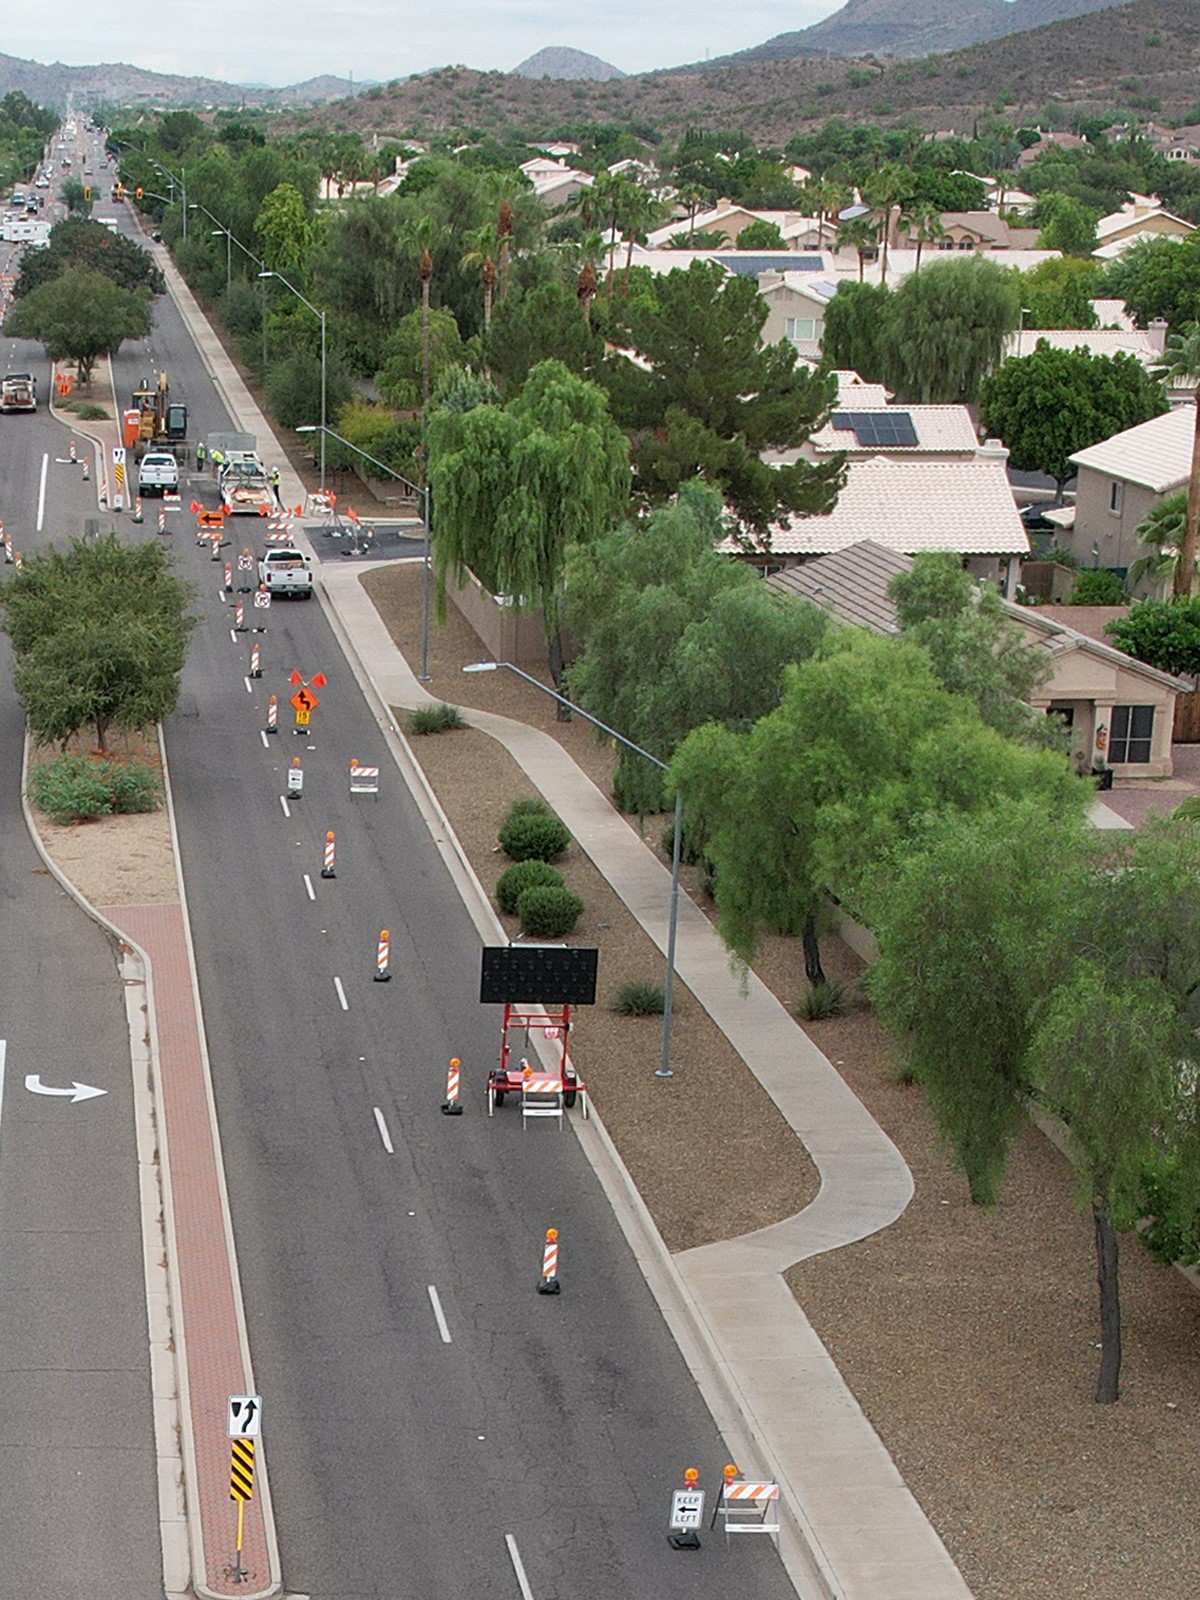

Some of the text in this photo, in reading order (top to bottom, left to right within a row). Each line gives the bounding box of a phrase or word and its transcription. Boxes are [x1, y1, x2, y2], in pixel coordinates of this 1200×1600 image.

[299, 711, 308, 720] 15
[677, 1496, 700, 1504] KEEP
[675, 1515, 696, 1523] LEFT
